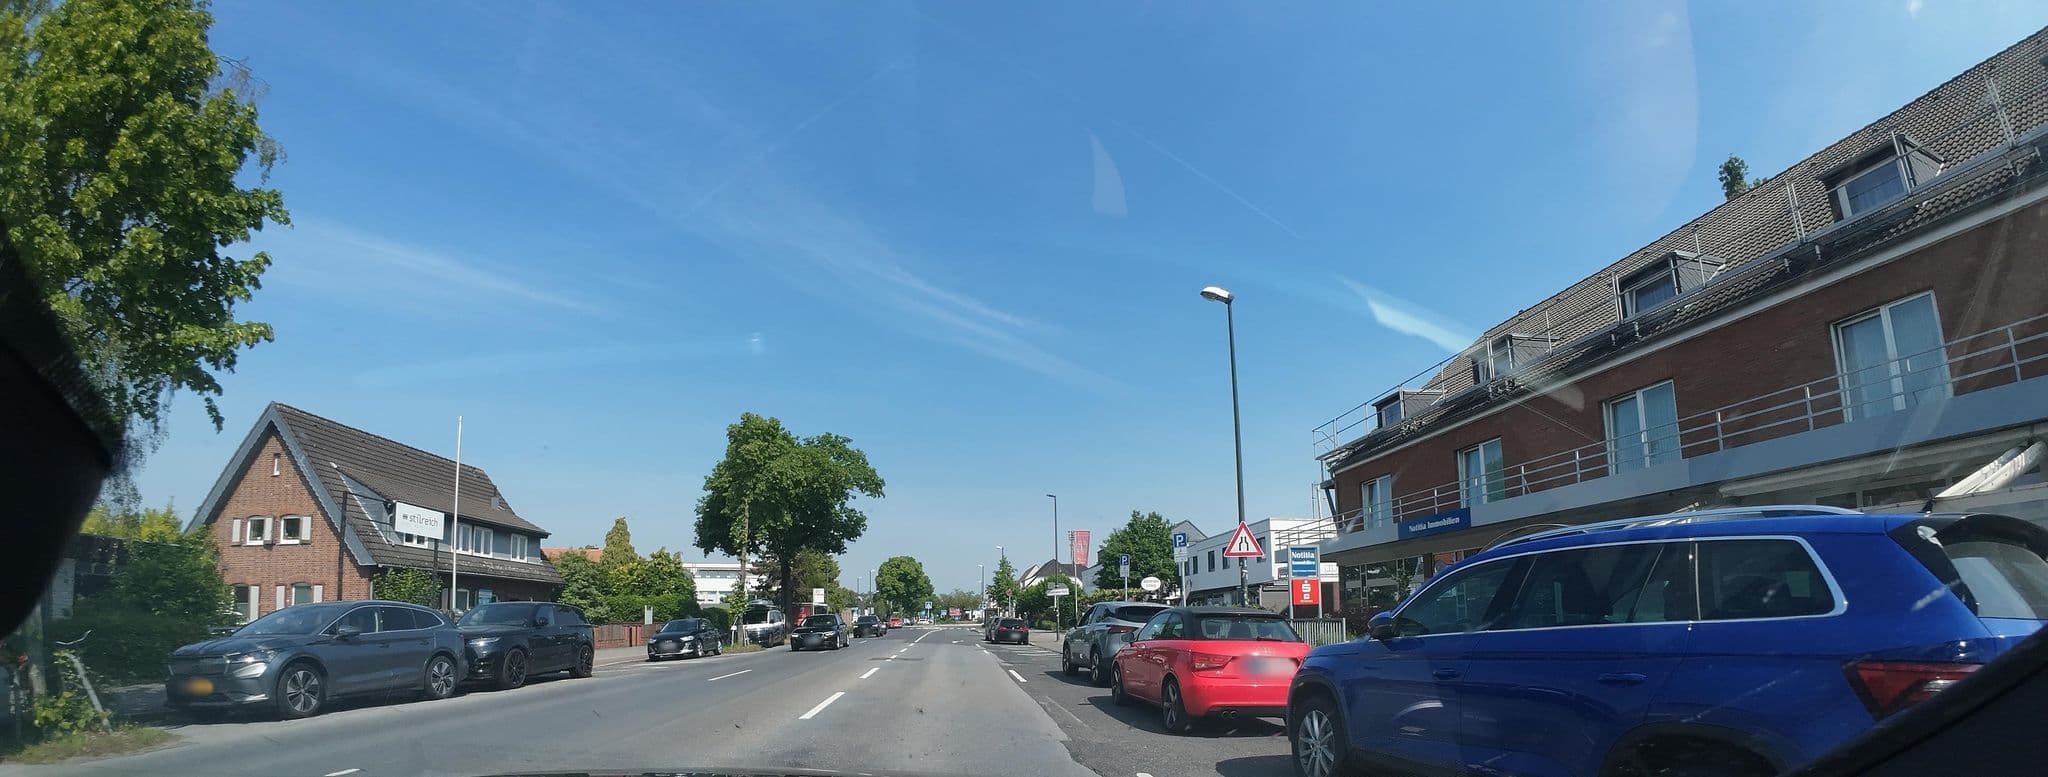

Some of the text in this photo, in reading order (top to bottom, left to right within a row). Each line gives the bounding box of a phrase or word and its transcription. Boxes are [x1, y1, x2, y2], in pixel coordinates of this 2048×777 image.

[409, 514, 439, 527] stilreich
[1428, 517, 1460, 528] Immobilien
[1176, 535, 1185, 547] P
[1122, 556, 1127, 564] P
